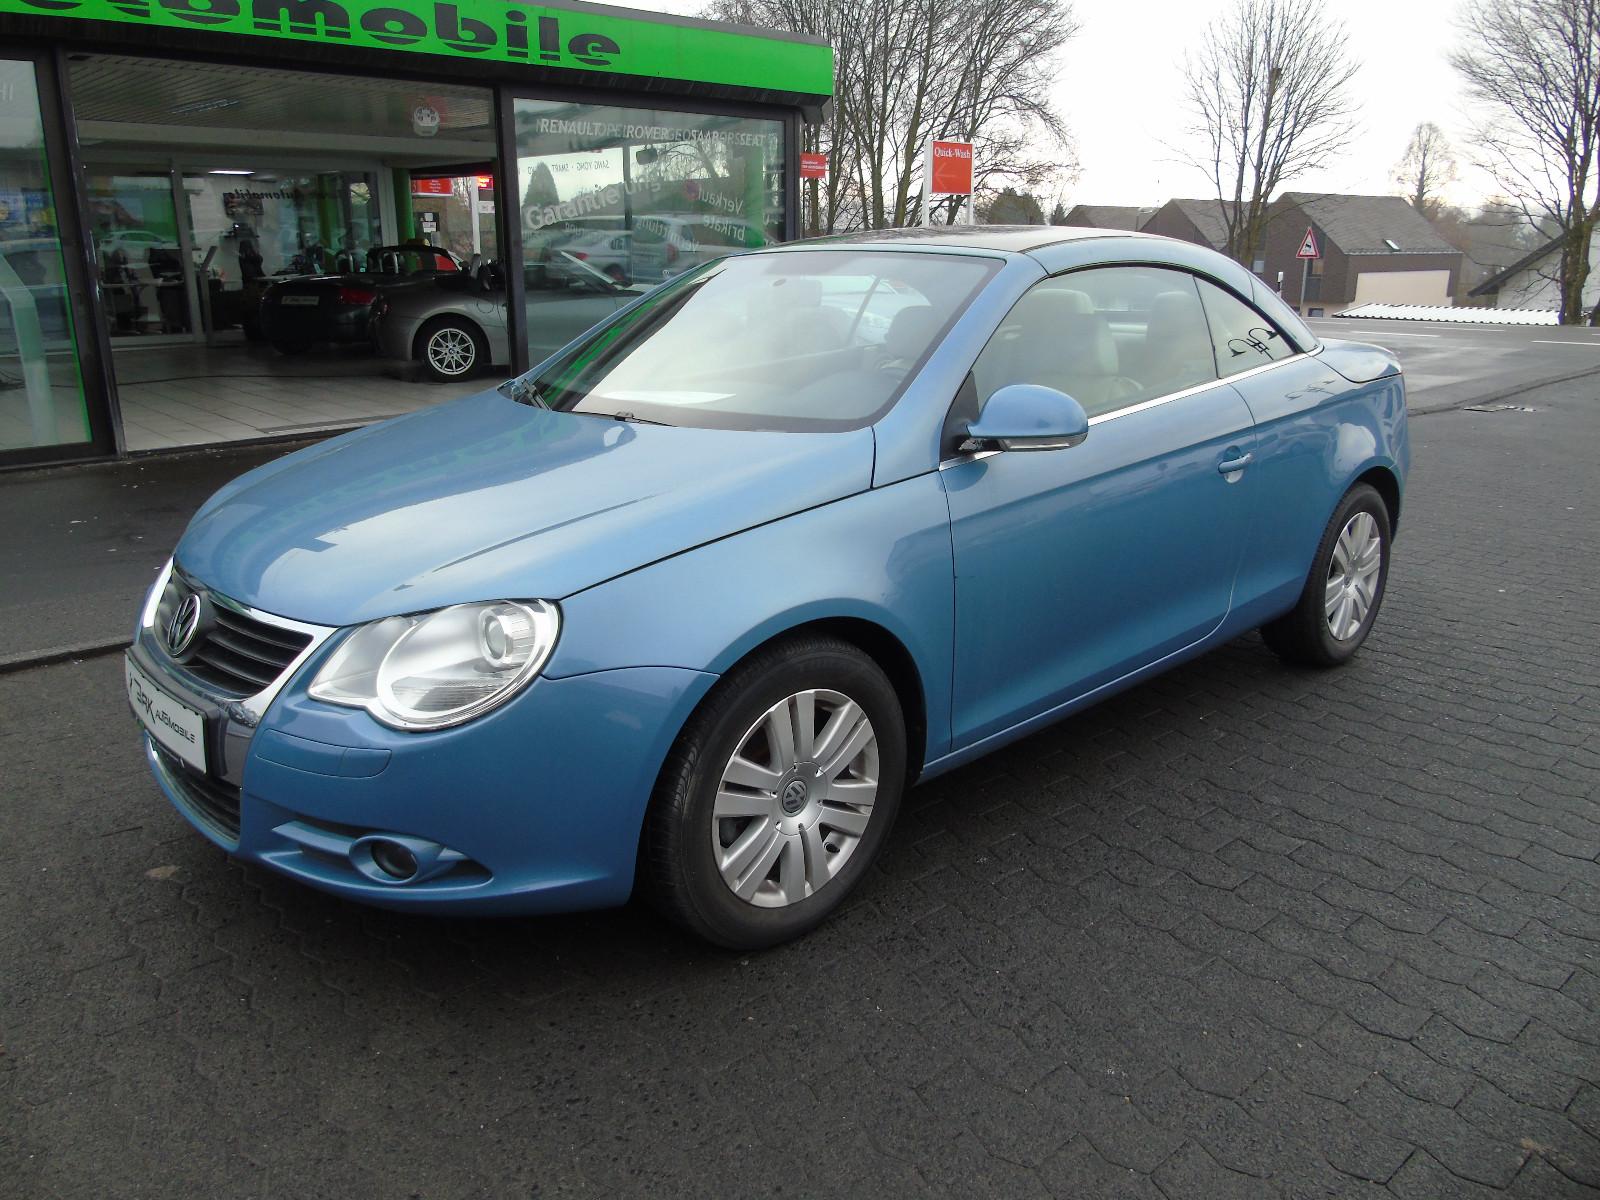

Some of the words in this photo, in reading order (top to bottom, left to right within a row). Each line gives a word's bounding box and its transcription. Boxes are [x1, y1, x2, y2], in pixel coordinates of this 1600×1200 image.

[541, 118, 601, 136] RENAULT
[627, 125, 668, 141] ROVER
[740, 133, 767, 147] SEAT
[934, 146, 971, 159] Quick-Wash
